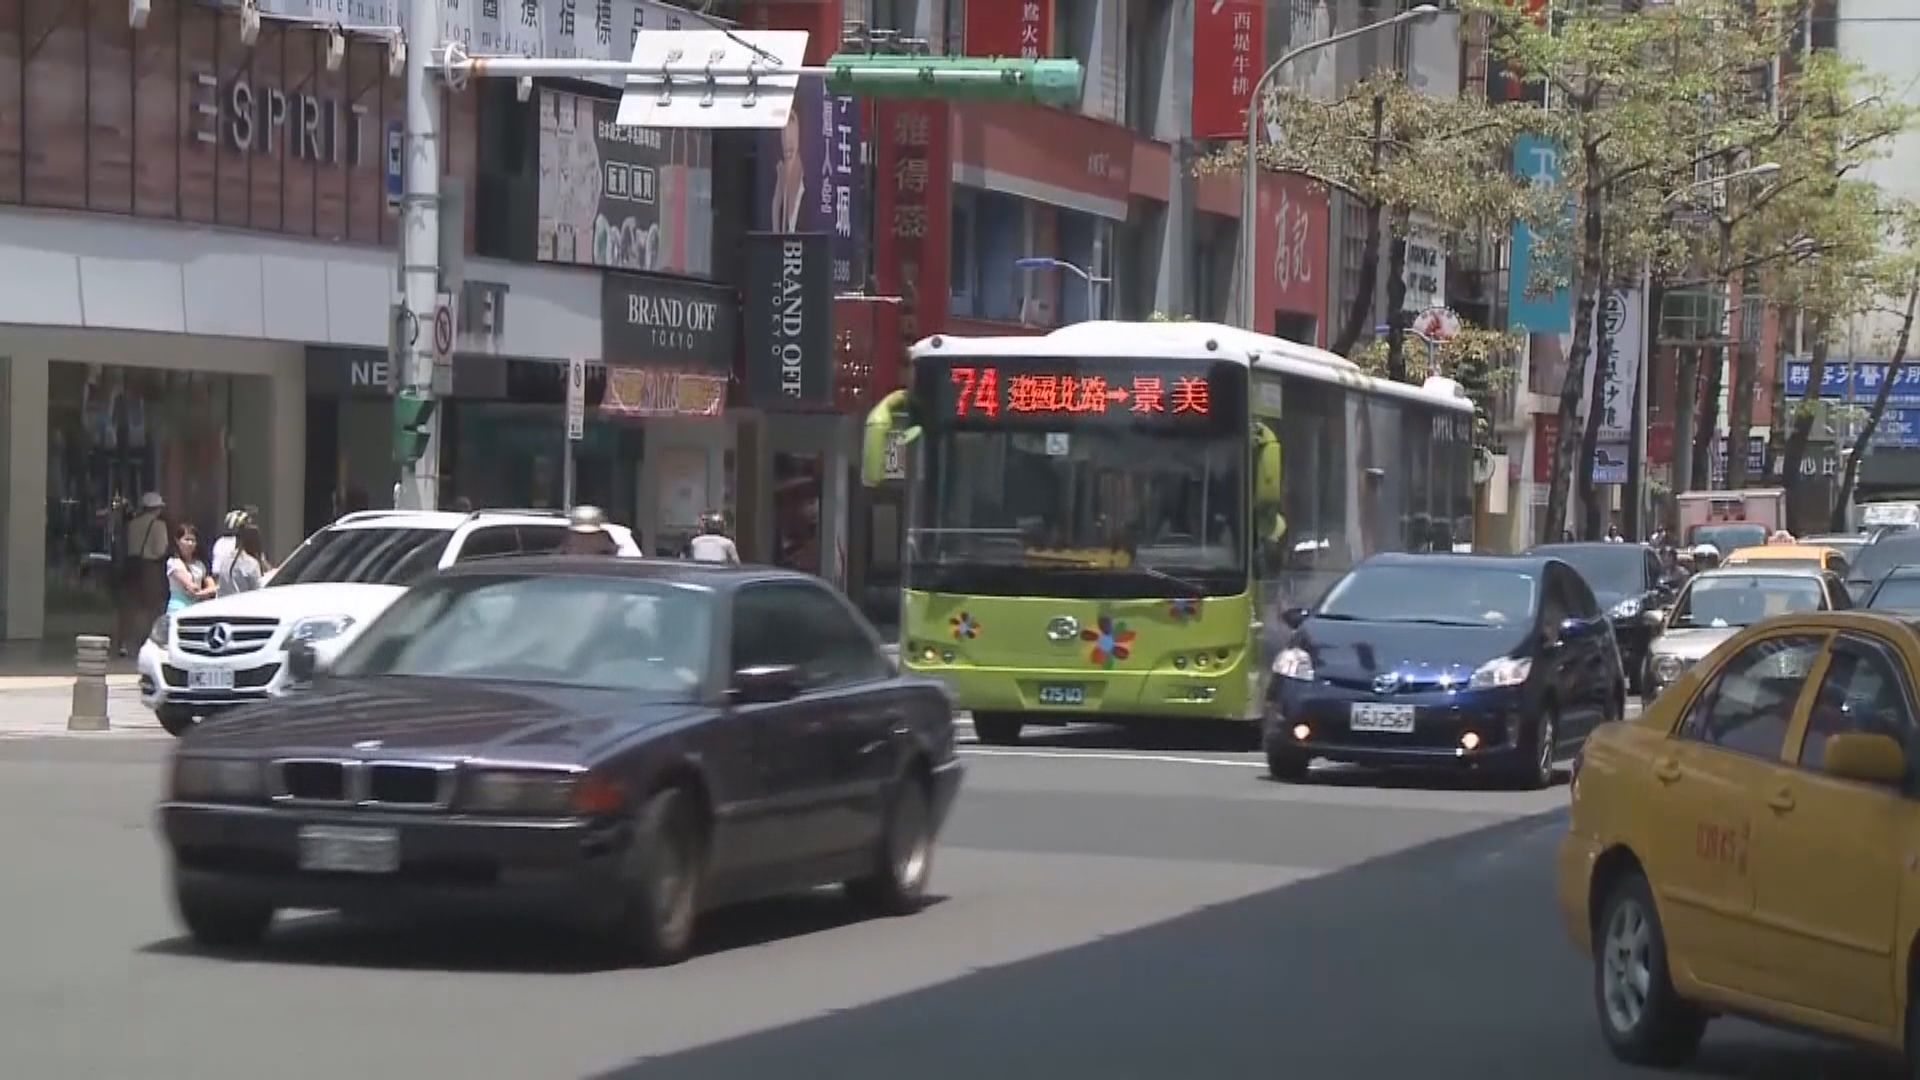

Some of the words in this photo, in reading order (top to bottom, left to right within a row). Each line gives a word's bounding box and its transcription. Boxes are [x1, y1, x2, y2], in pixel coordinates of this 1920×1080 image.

[197, 71, 368, 168] ESPRIT
[1274, 188, 1312, 293] 高記
[628, 294, 682, 328] BRAND
[686, 301, 718, 331] OFF
[772, 281, 782, 356] TOKYO
[782, 241, 803, 337] BRAND
[651, 328, 694, 350] TOKYO
[781, 344, 803, 399] OFF
[950, 367, 1000, 417] 74
[1007, 375, 1105, 412] 建國北路
[1129, 375, 1210, 414] 景美
